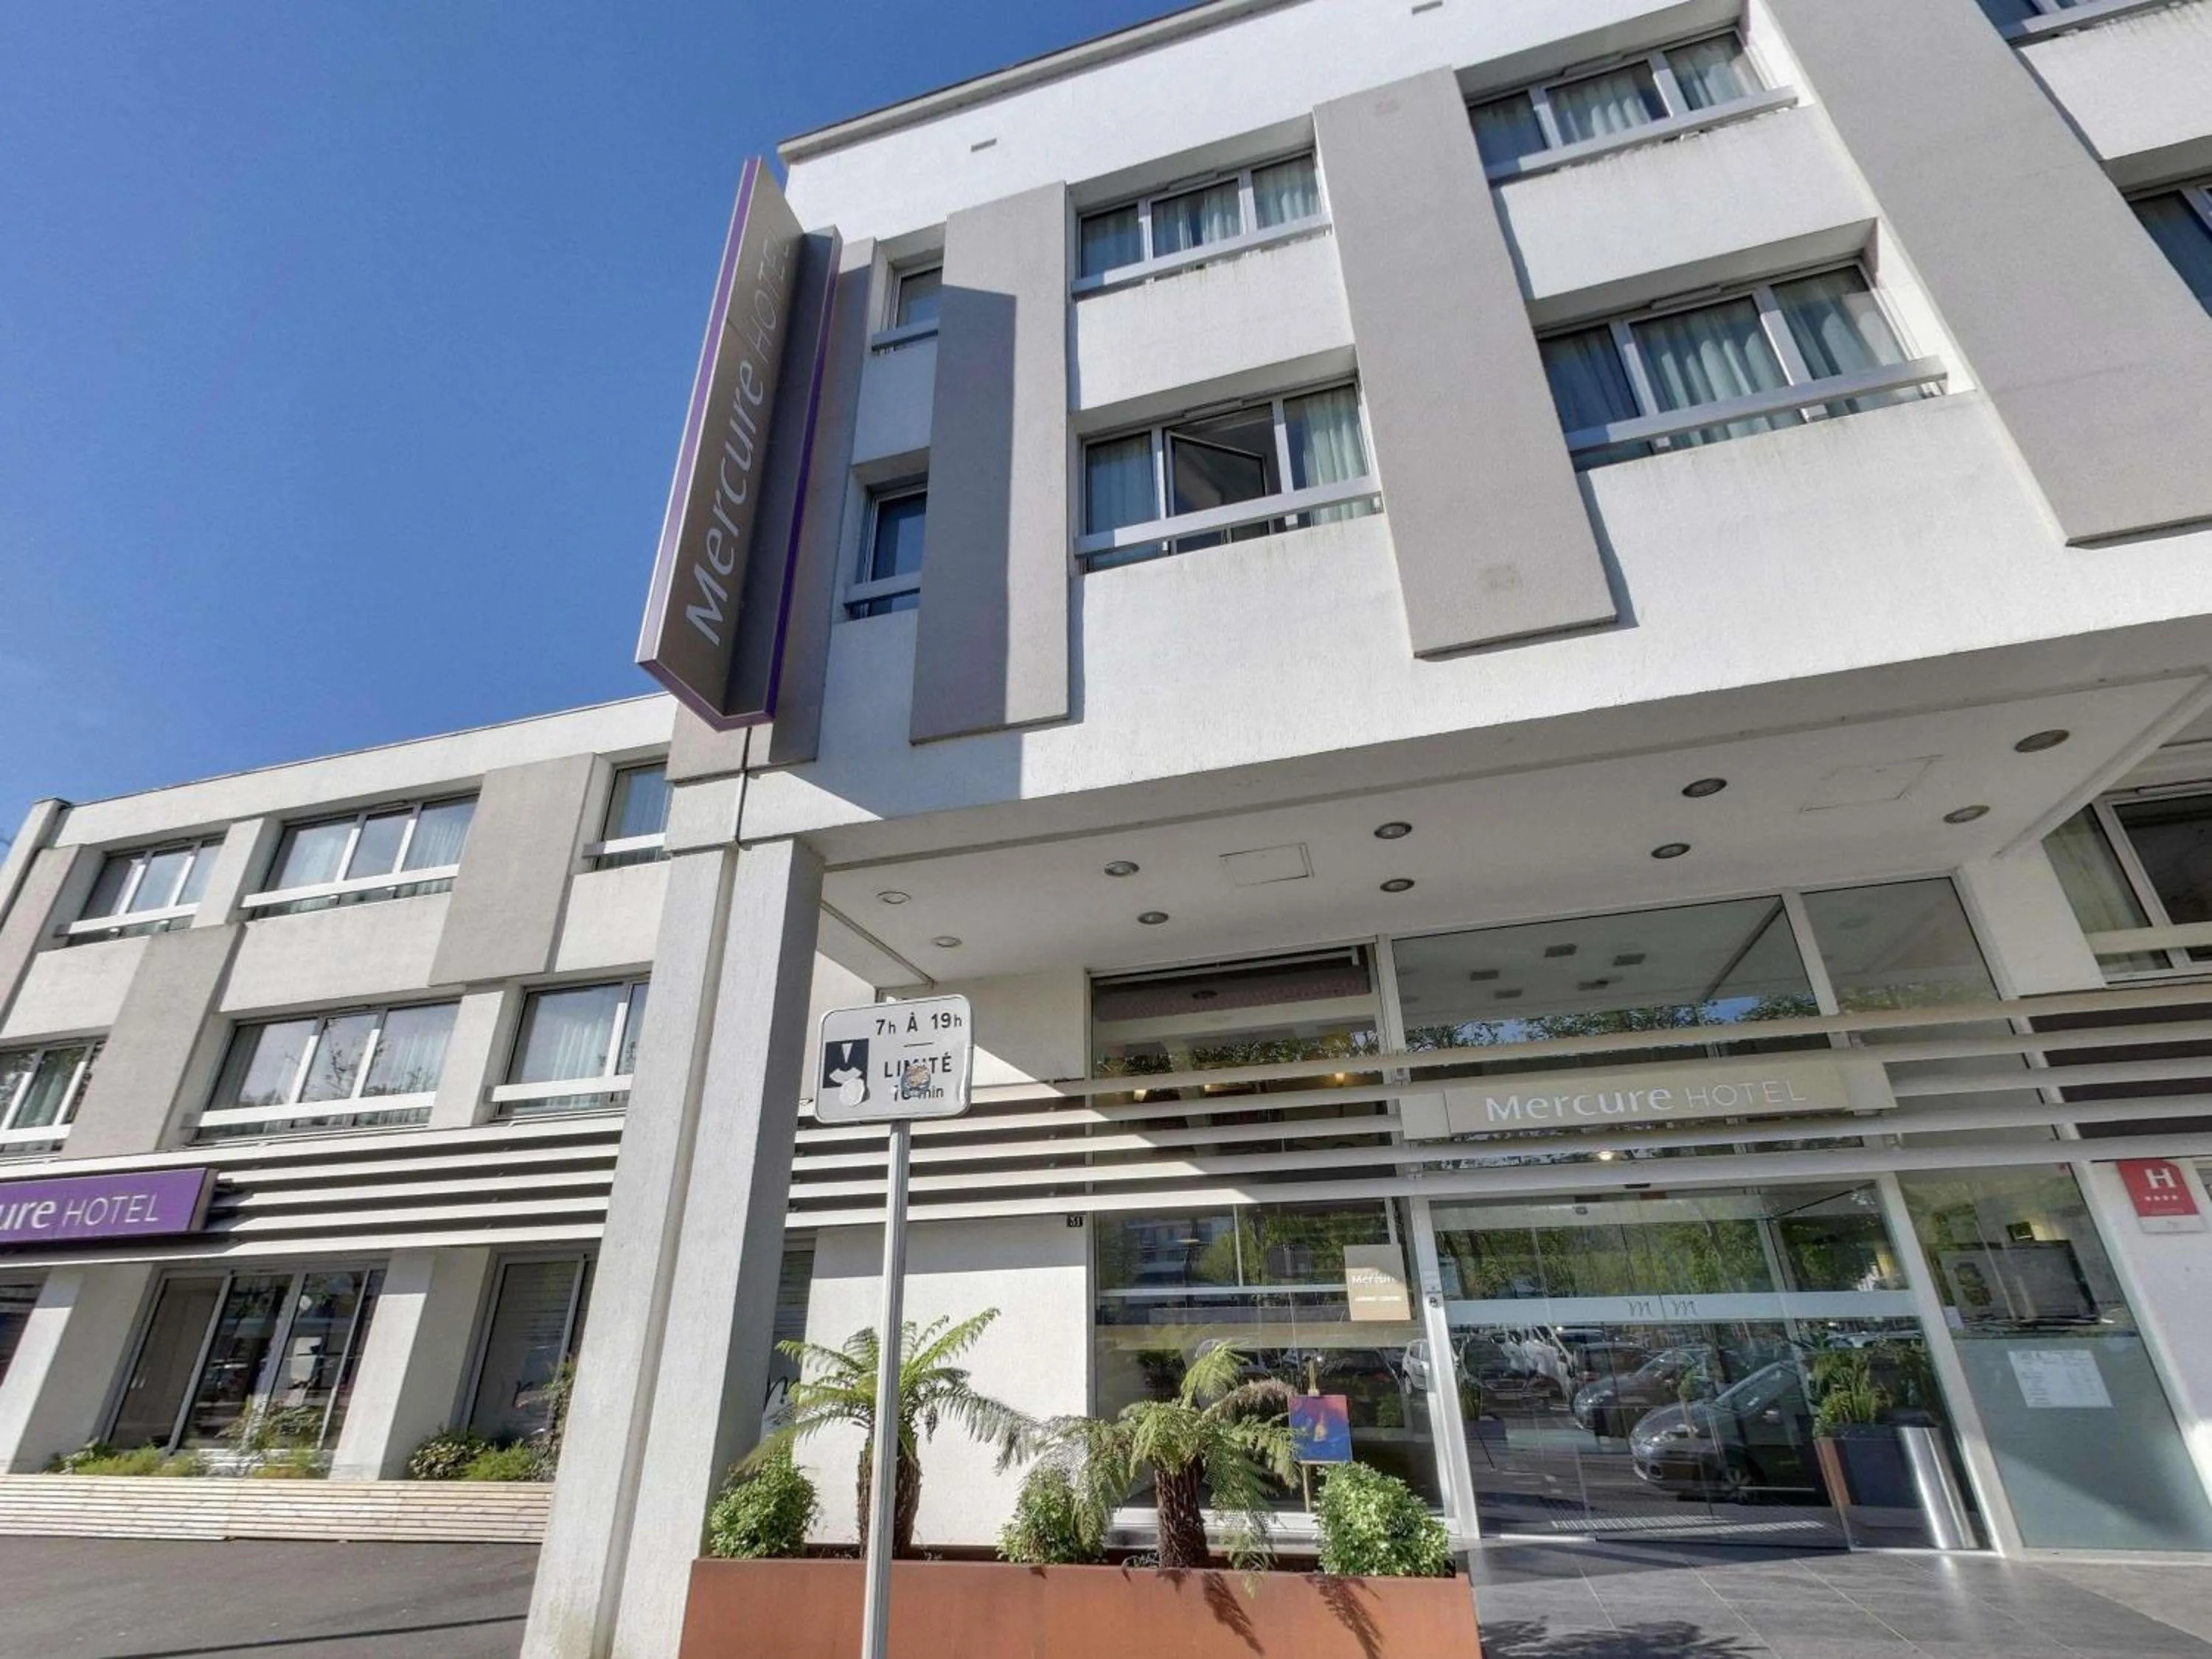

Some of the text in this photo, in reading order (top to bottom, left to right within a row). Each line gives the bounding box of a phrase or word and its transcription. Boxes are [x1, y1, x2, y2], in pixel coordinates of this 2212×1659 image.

[686, 226, 790, 646] Mercure HOTEL
[875, 1018, 896, 1035] 7h
[931, 1012, 962, 1030] 19h
[884, 1051, 952, 1078] LITÉ
[1485, 1079, 1806, 1121] Mercure HOTEL
[2144, 1168, 2177, 1189] H
[62, 1194, 159, 1228] HOTEL
